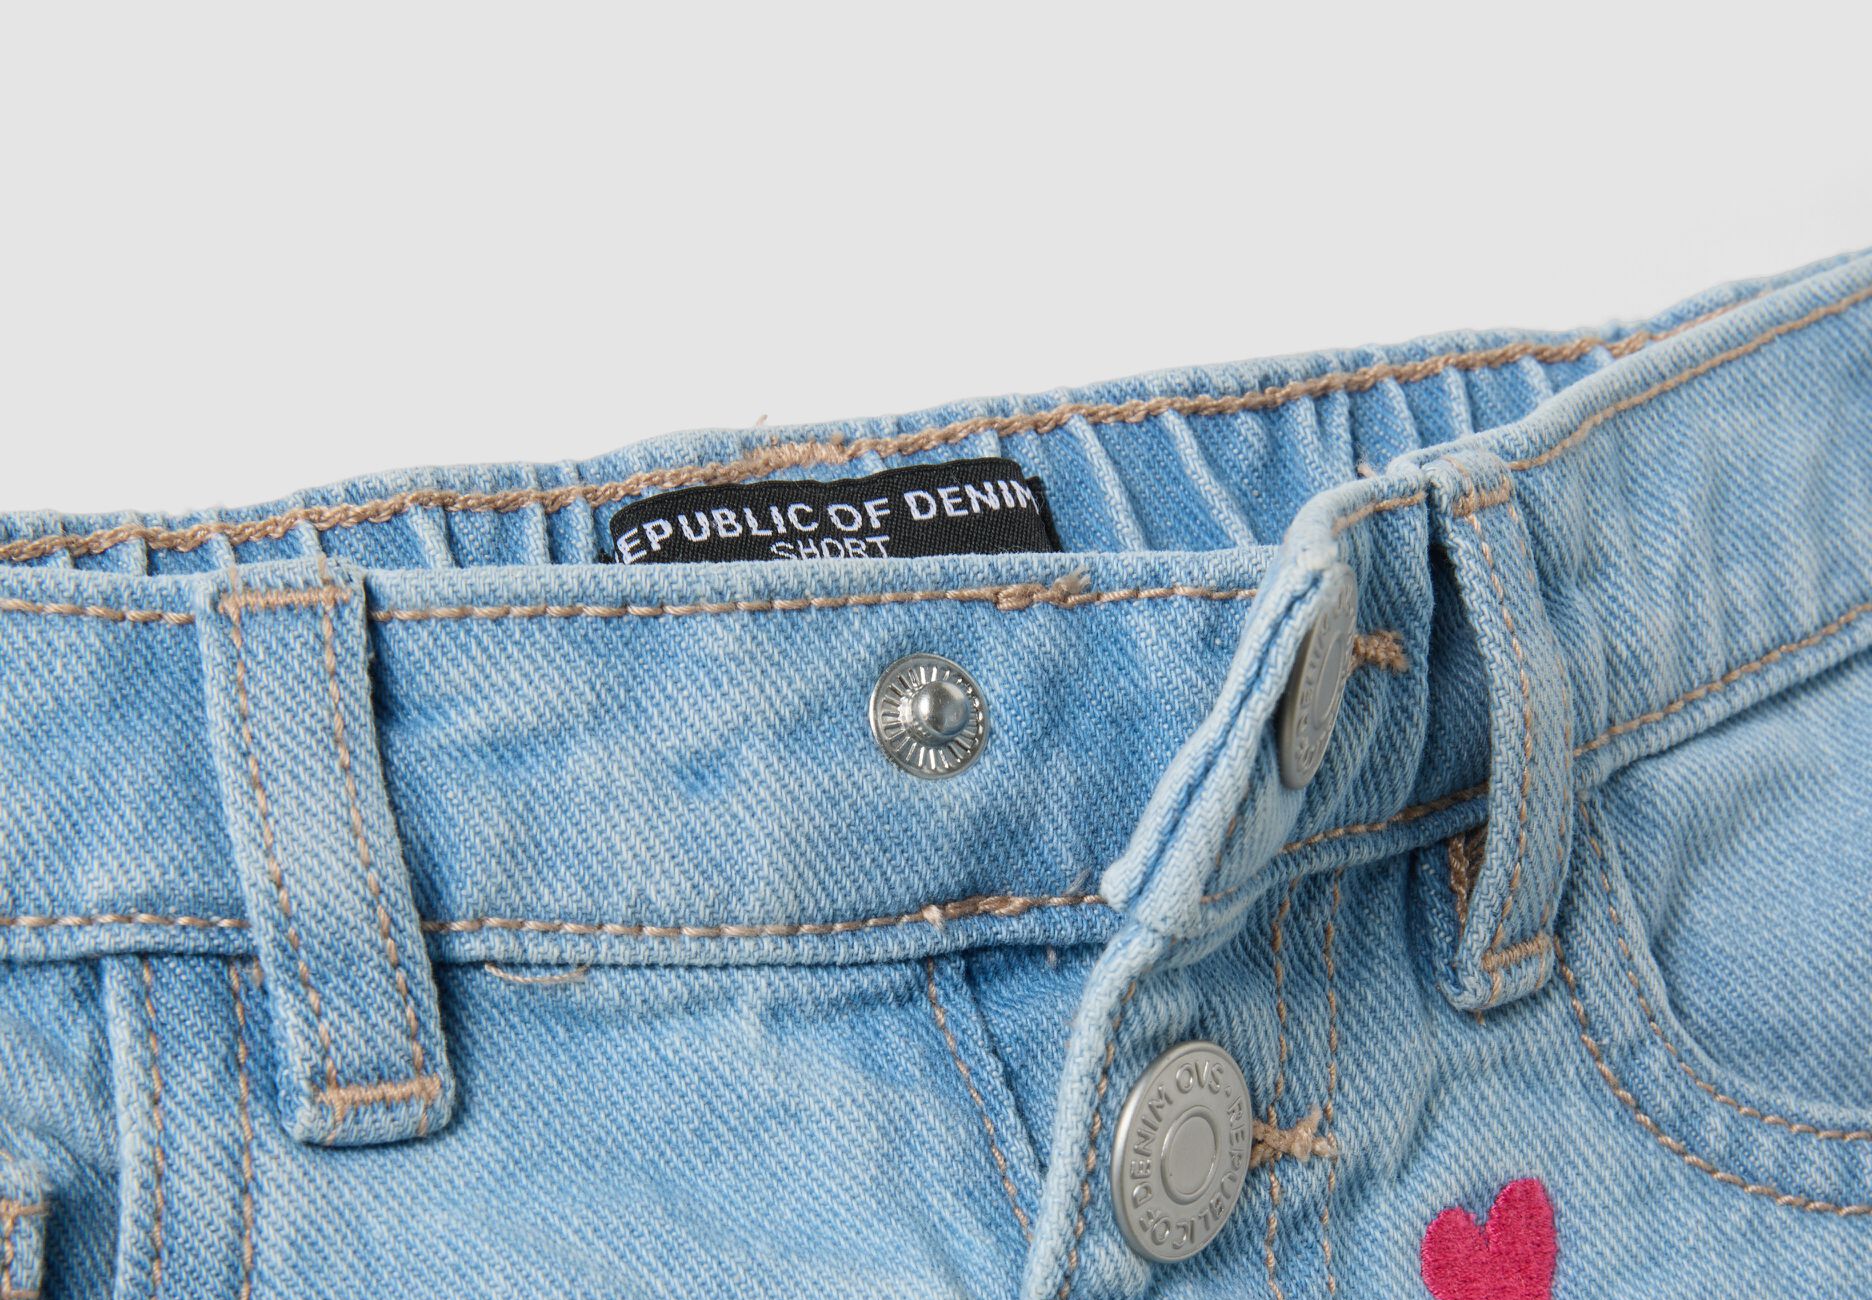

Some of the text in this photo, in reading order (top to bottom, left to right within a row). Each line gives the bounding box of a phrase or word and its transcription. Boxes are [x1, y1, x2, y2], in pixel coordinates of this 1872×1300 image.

[615, 479, 1040, 565] EPUBLIC OF DENIM
[1175, 1060, 1225, 1094] OVS
[1130, 1085, 1174, 1208] DENIM
[1172, 1096, 1246, 1250] REPUBLIC
